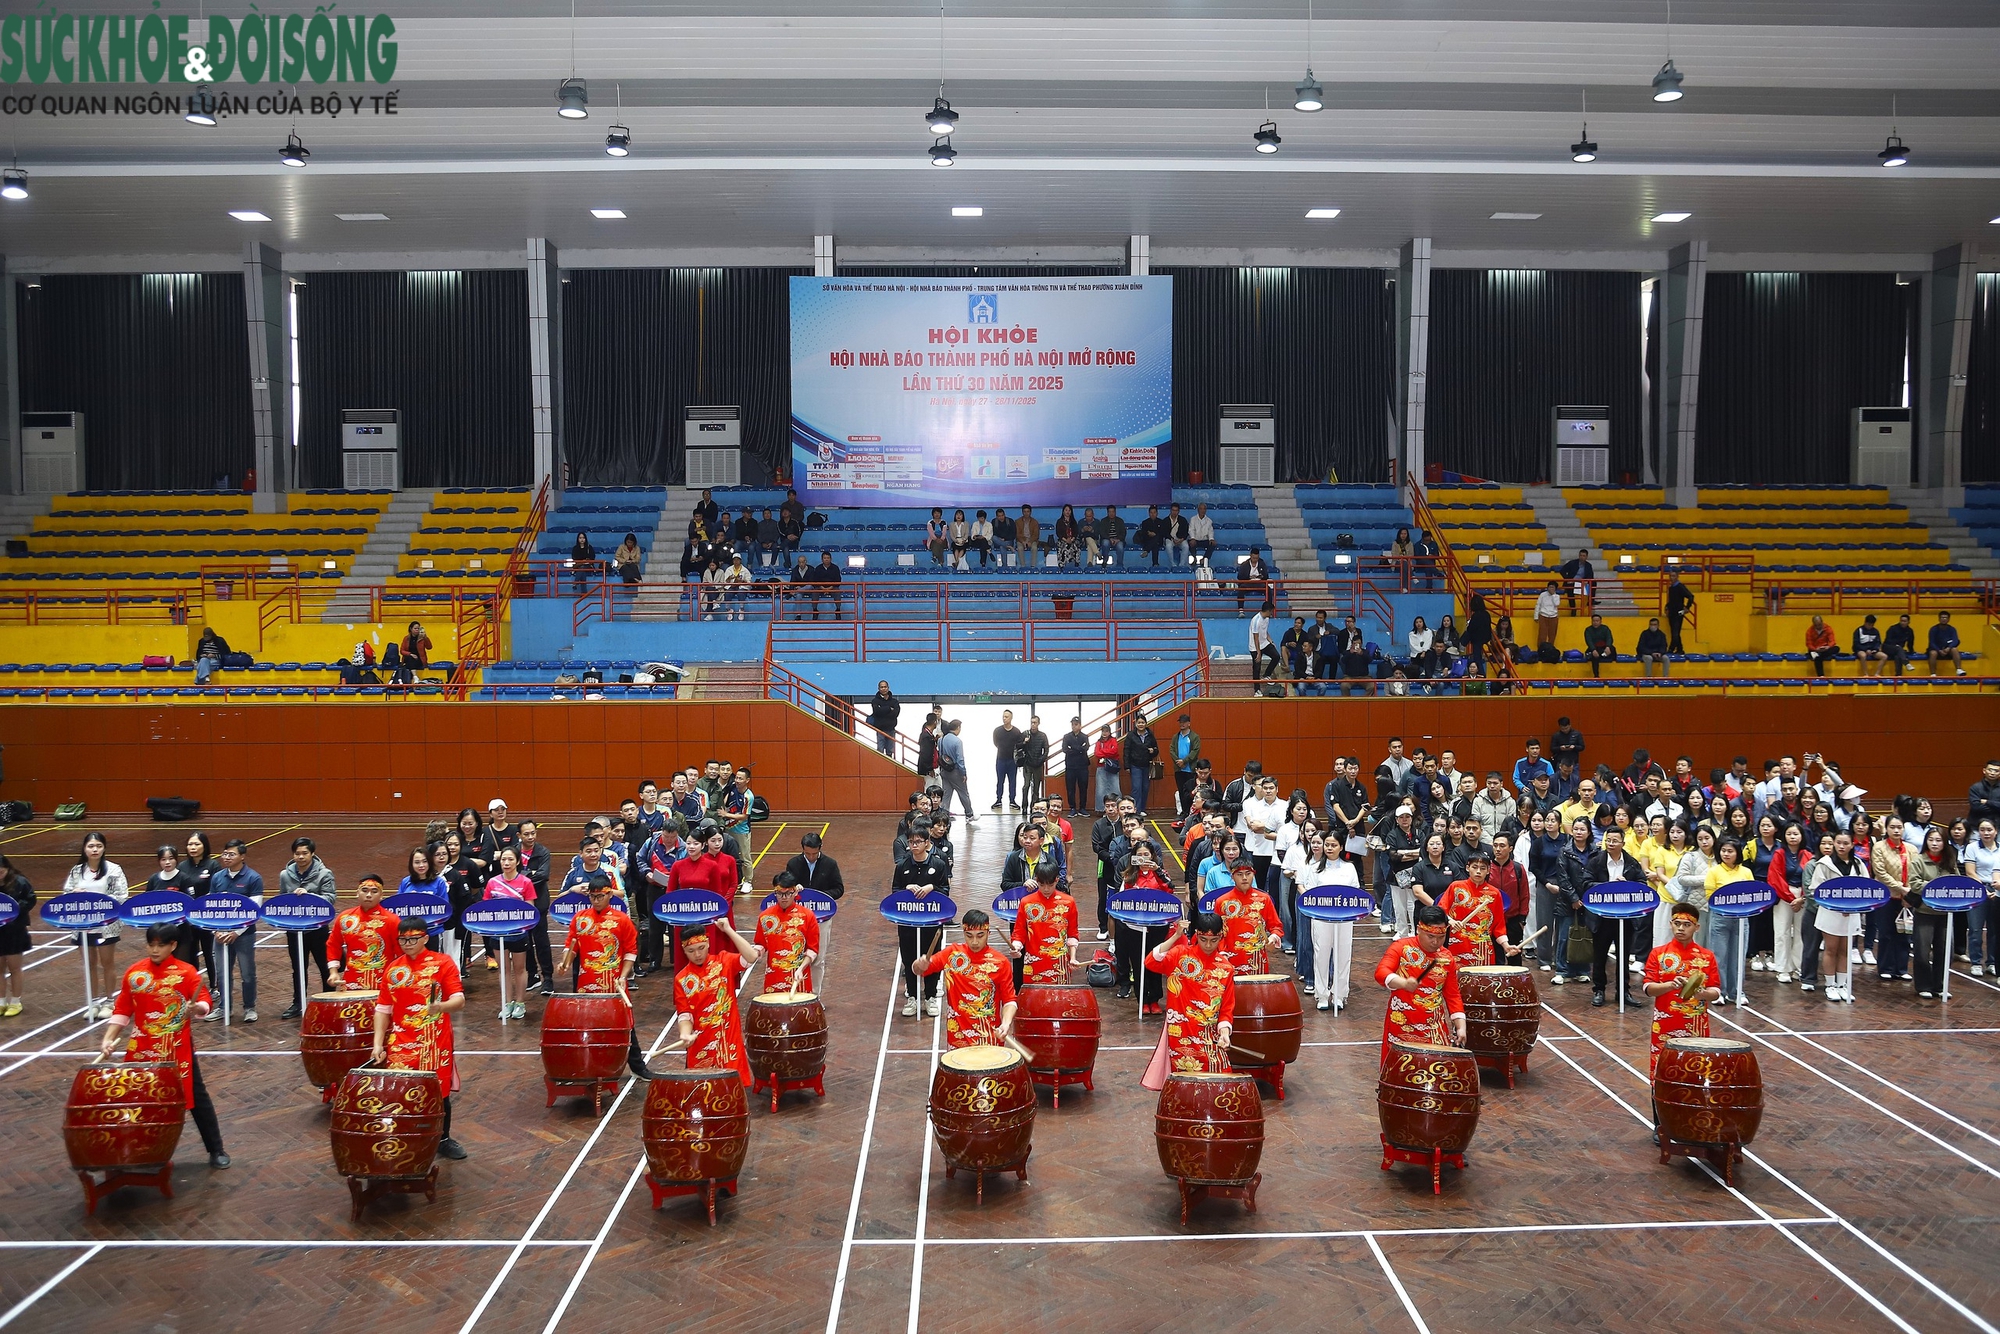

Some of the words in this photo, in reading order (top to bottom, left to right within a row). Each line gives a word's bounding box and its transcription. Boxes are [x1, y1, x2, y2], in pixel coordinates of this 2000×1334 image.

[928, 325, 968, 348] HỘI
[978, 324, 1038, 343] KHỎE
[830, 348, 854, 369] HỘI
[859, 349, 889, 367] NHÀ
[894, 349, 922, 367] BÁO
[928, 349, 976, 367] THÀNH
[981, 346, 1010, 367] PHỐ
[1014, 348, 1036, 366] HÀ
[1039, 349, 1063, 370] NỘI
[1069, 346, 1092, 366] MỞ
[1096, 349, 1136, 369] RỘNG
[903, 371, 931, 391] LẦN
[936, 373, 964, 391] THỨ
[968, 376, 985, 391] 30
[989, 374, 1024, 391] NĂM
[1028, 376, 1064, 391] 2025
[1589, 892, 1602, 903] BÁO
[1603, 893, 1613, 903] AN
[1614, 893, 1630, 902] NINH
[1631, 890, 1643, 902] THỦ
[1644, 890, 1653, 901] ĐÔ
[1714, 894, 1725, 905] BÁO
[1726, 895, 1736, 904] LAO
[1738, 892, 1752, 905] ĐỘNG
[1753, 890, 1763, 902] THỦ
[1764, 889, 1771, 901] ĐÔ
[1819, 889, 1831, 900] TẠP
[1832, 887, 1842, 898] CHÍ
[1863, 887, 1872, 898] HÀ
[1873, 888, 1884, 900] NỘI
[49, 903, 63, 914] TẠP
[65, 901, 77, 911] CHÍ
[79, 901, 91, 911] ĐỜI
[93, 899, 113, 910] SỐNG
[205, 900, 217, 908] BAN
[218, 899, 230, 907] LIÊN
[231, 900, 242, 908] LẠC
[662, 901, 677, 912] BÁO
[679, 901, 700, 912] NHÂN
[702, 900, 718, 911] DÂN
[817, 901, 830, 911] NAM
[896, 902, 925, 913] TRỌNG
[926, 901, 940, 912] TÀI
[998, 899, 1008, 911] HỘI
[1111, 899, 1121, 912] HỘI
[1122, 899, 1134, 911] NHÀ
[1135, 900, 1147, 911] BÁO
[1148, 900, 1158, 912] HẢI
[1159, 901, 1179, 913] PHÒNG
[1303, 894, 1316, 906] BÁO
[1317, 896, 1332, 906] KINH
[1334, 894, 1342, 906] TẾ
[1343, 897, 1348, 907] &
[1349, 895, 1358, 907] ĐÔ
[132, 902, 183, 917] VNEXPRESS
[190, 909, 201, 918] NHÀ
[202, 909, 213, 918] BÁO
[239, 909, 246, 918] HÀ
[265, 904, 277, 915] BÁO
[277, 904, 291, 915] PHÁP
[292, 904, 305, 918] LUẬT
[305, 904, 316, 918] VIỆT
[317, 906, 329, 916] NAM
[395, 904, 408, 916] CHÍ
[409, 904, 430, 916] NGÀY
[431, 904, 446, 914] NAY
[554, 902, 574, 913] THÔNG
[67, 912, 86, 922] PHÁP
[88, 911, 105, 921] LUẬT
[466, 911, 477, 922] BÁO
[478, 910, 493, 921] NÔNG
[494, 909, 508, 920] THÔN
[509, 908, 523, 920] NGÀY
[524, 910, 534, 919] NAY
